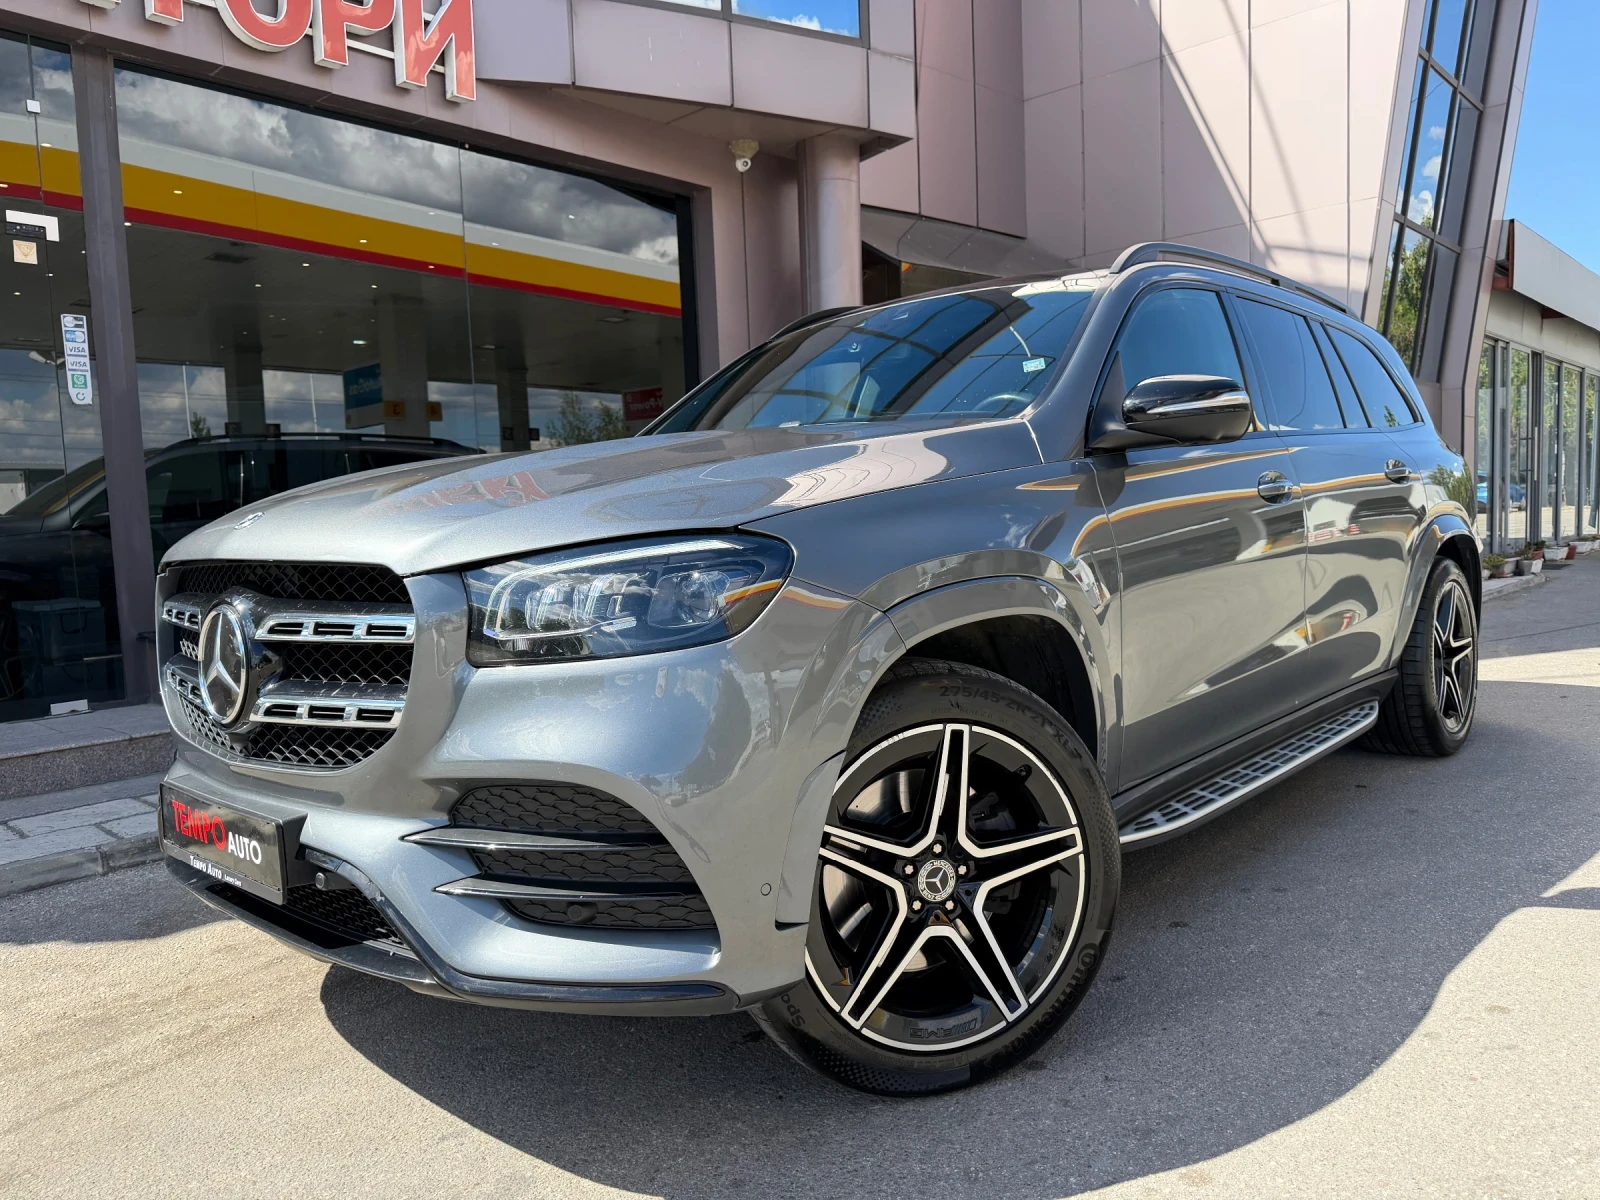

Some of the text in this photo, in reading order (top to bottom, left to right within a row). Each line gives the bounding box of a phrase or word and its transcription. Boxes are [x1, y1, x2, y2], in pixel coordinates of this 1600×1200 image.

[80, 0, 476, 102] ОРИ
[68, 346, 86, 354] VISA
[939, 685, 1001, 704] 275/45
[171, 799, 262, 865] TEMPO AUTO
[909, 1026, 954, 1041] AMG
